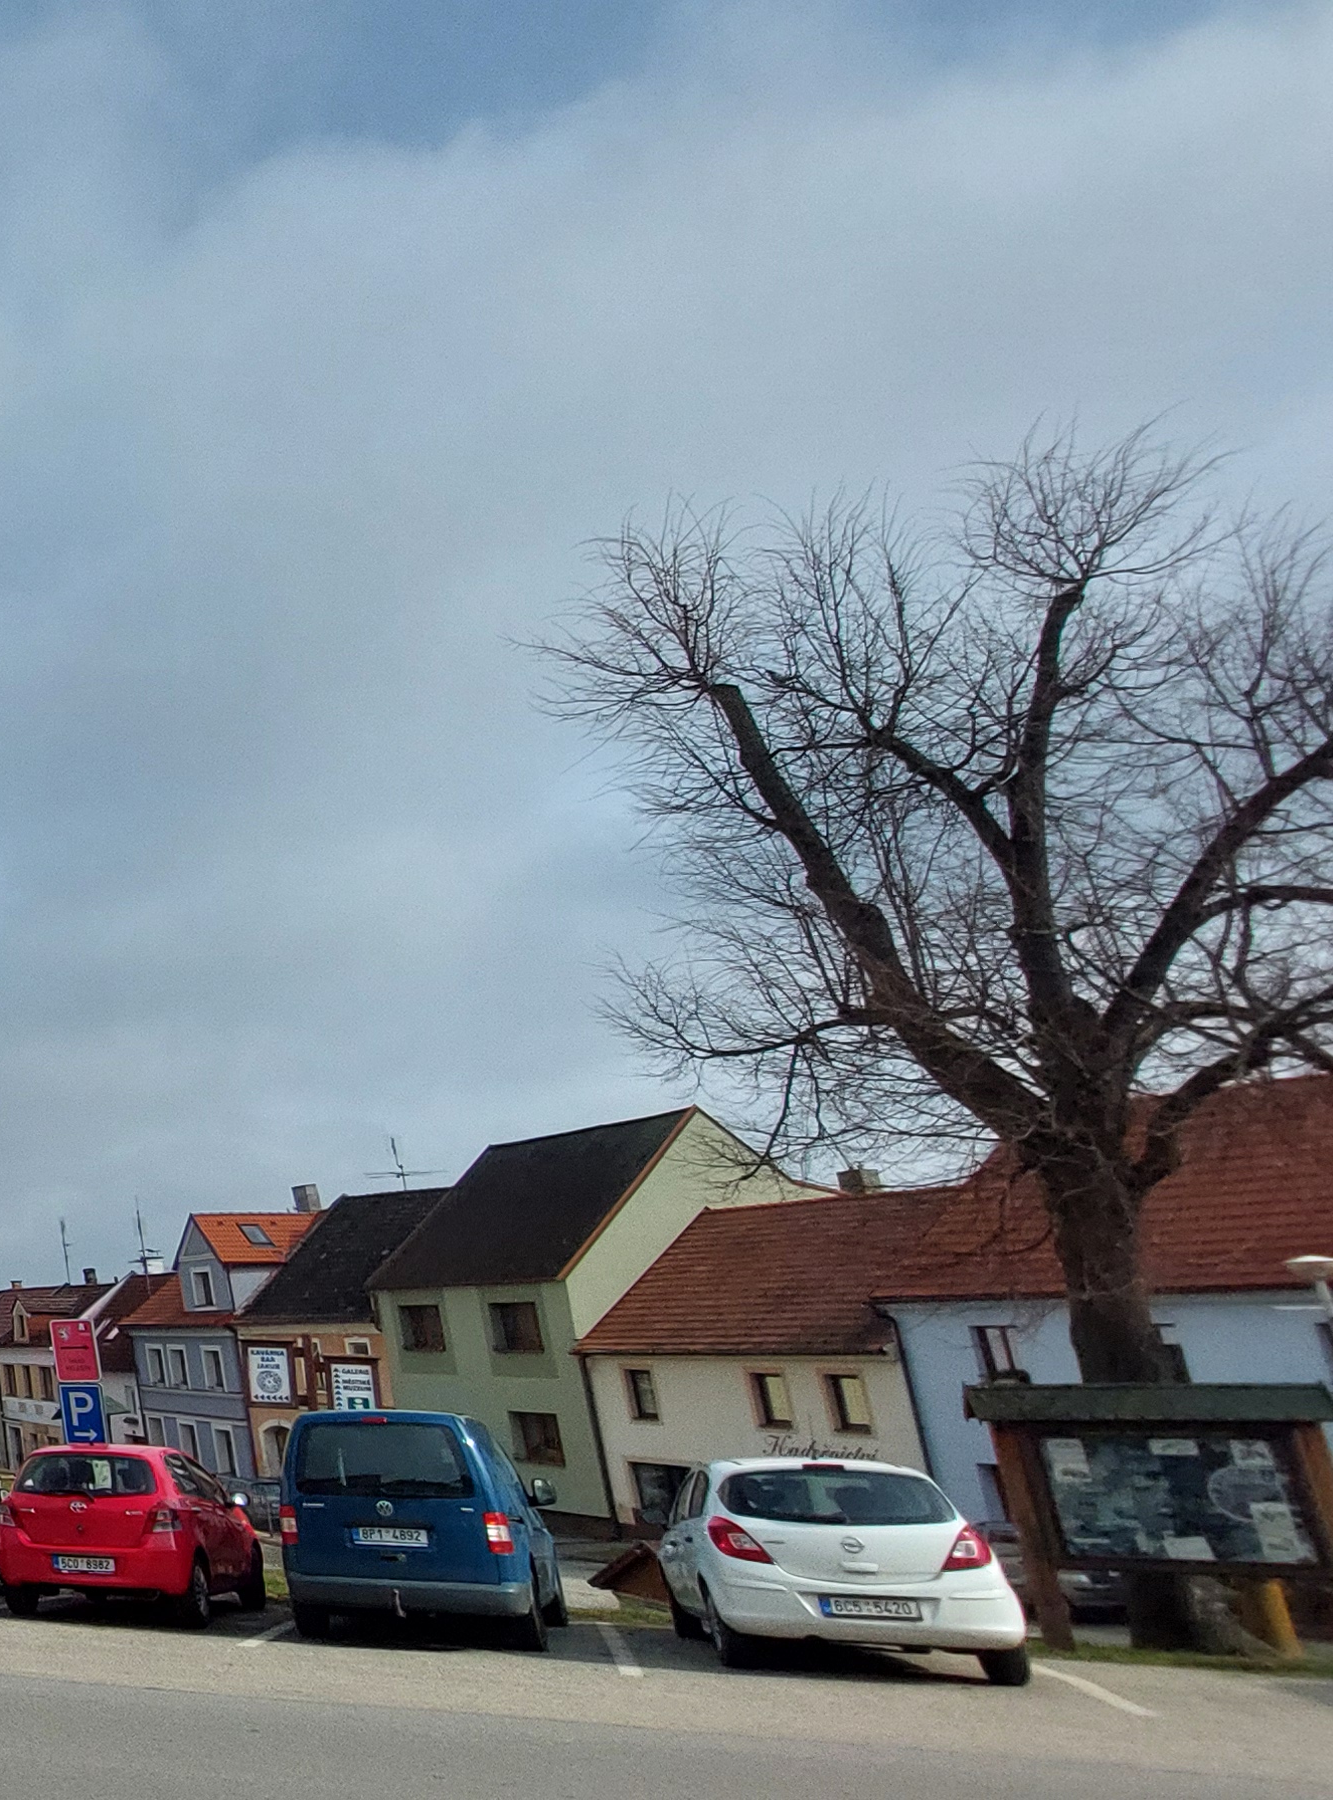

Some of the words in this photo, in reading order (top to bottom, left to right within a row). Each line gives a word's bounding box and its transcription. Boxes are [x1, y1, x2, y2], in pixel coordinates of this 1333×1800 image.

[68, 1391, 93, 1426] P
[361, 1529, 383, 1540] 8P1
[392, 1530, 422, 1542] 4892
[834, 1600, 863, 1613] 6C5
[873, 1601, 913, 1616] 5420
